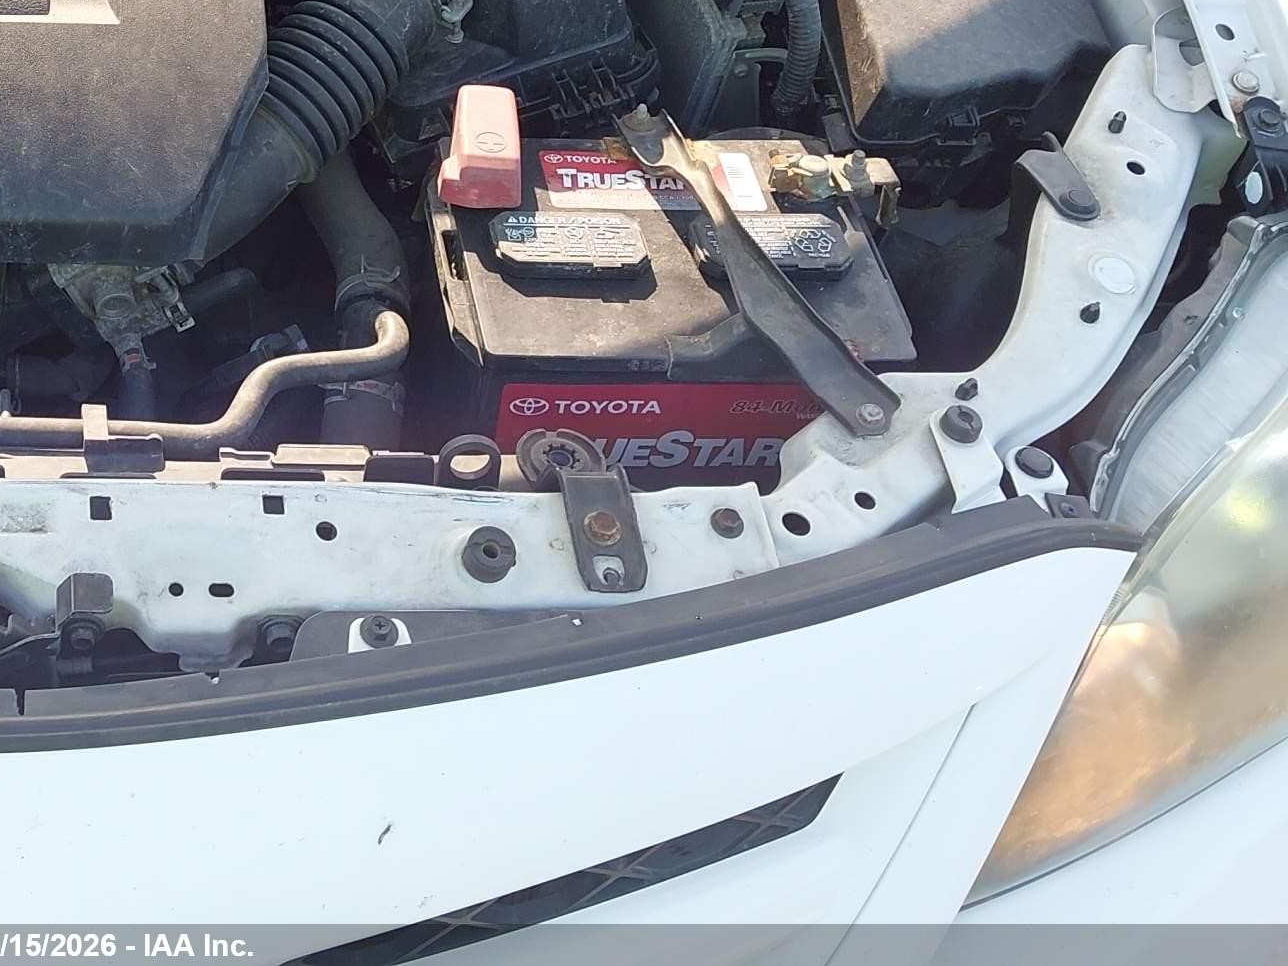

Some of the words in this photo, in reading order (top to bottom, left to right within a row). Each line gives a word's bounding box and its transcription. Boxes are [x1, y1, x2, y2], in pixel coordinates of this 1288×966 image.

[565, 155, 617, 164] TOYOTA
[518, 216, 567, 224] DANGER
[576, 217, 621, 225] POISON
[555, 400, 662, 415] TOYOTA
